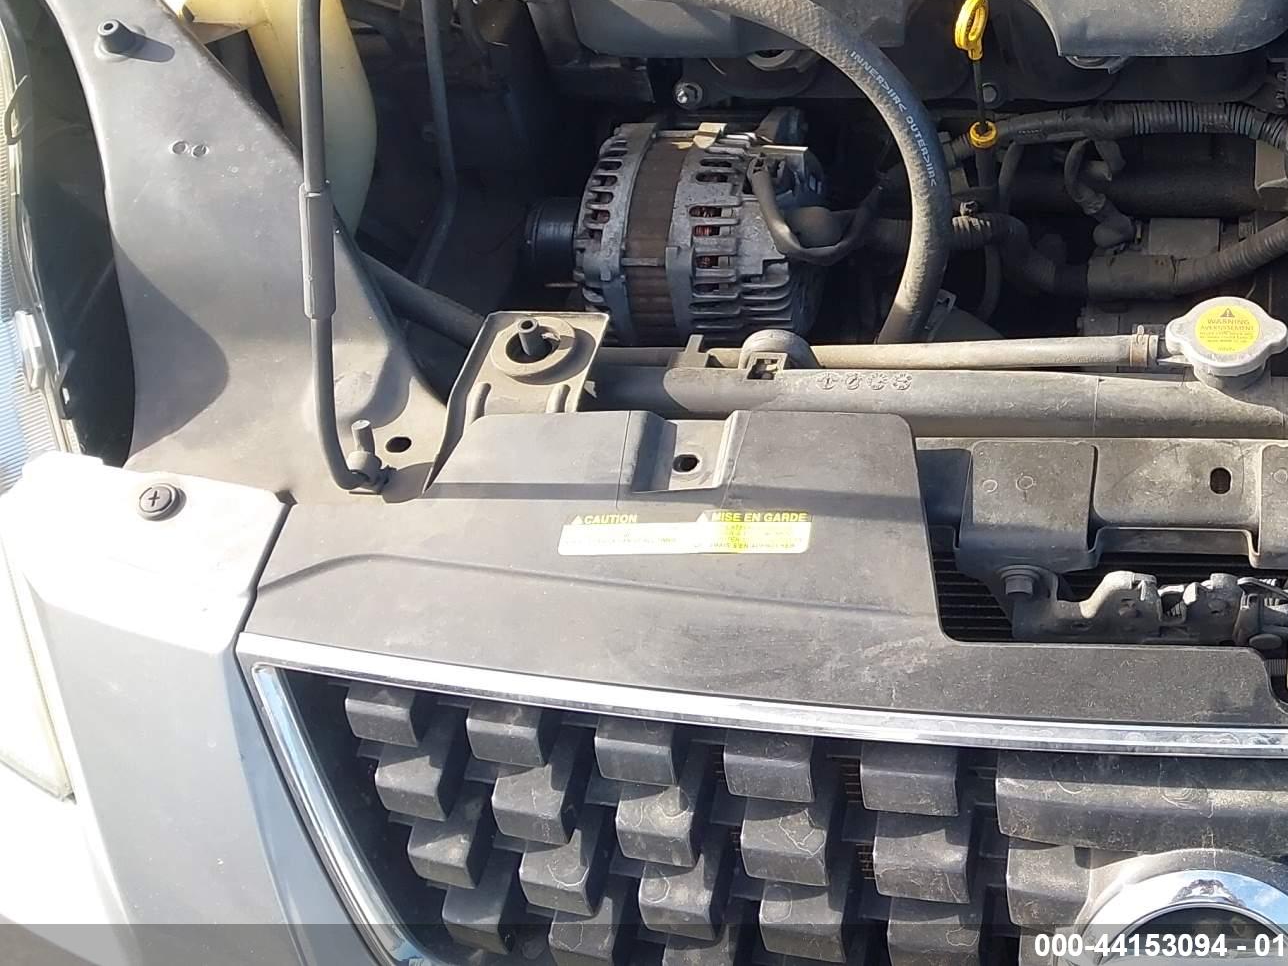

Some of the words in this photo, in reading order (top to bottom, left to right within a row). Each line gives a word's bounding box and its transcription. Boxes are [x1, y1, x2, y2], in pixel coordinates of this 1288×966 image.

[584, 514, 638, 524] CAUTION
[711, 512, 743, 522] MISE
[744, 512, 761, 522] EN
[763, 512, 809, 522] GARDE
